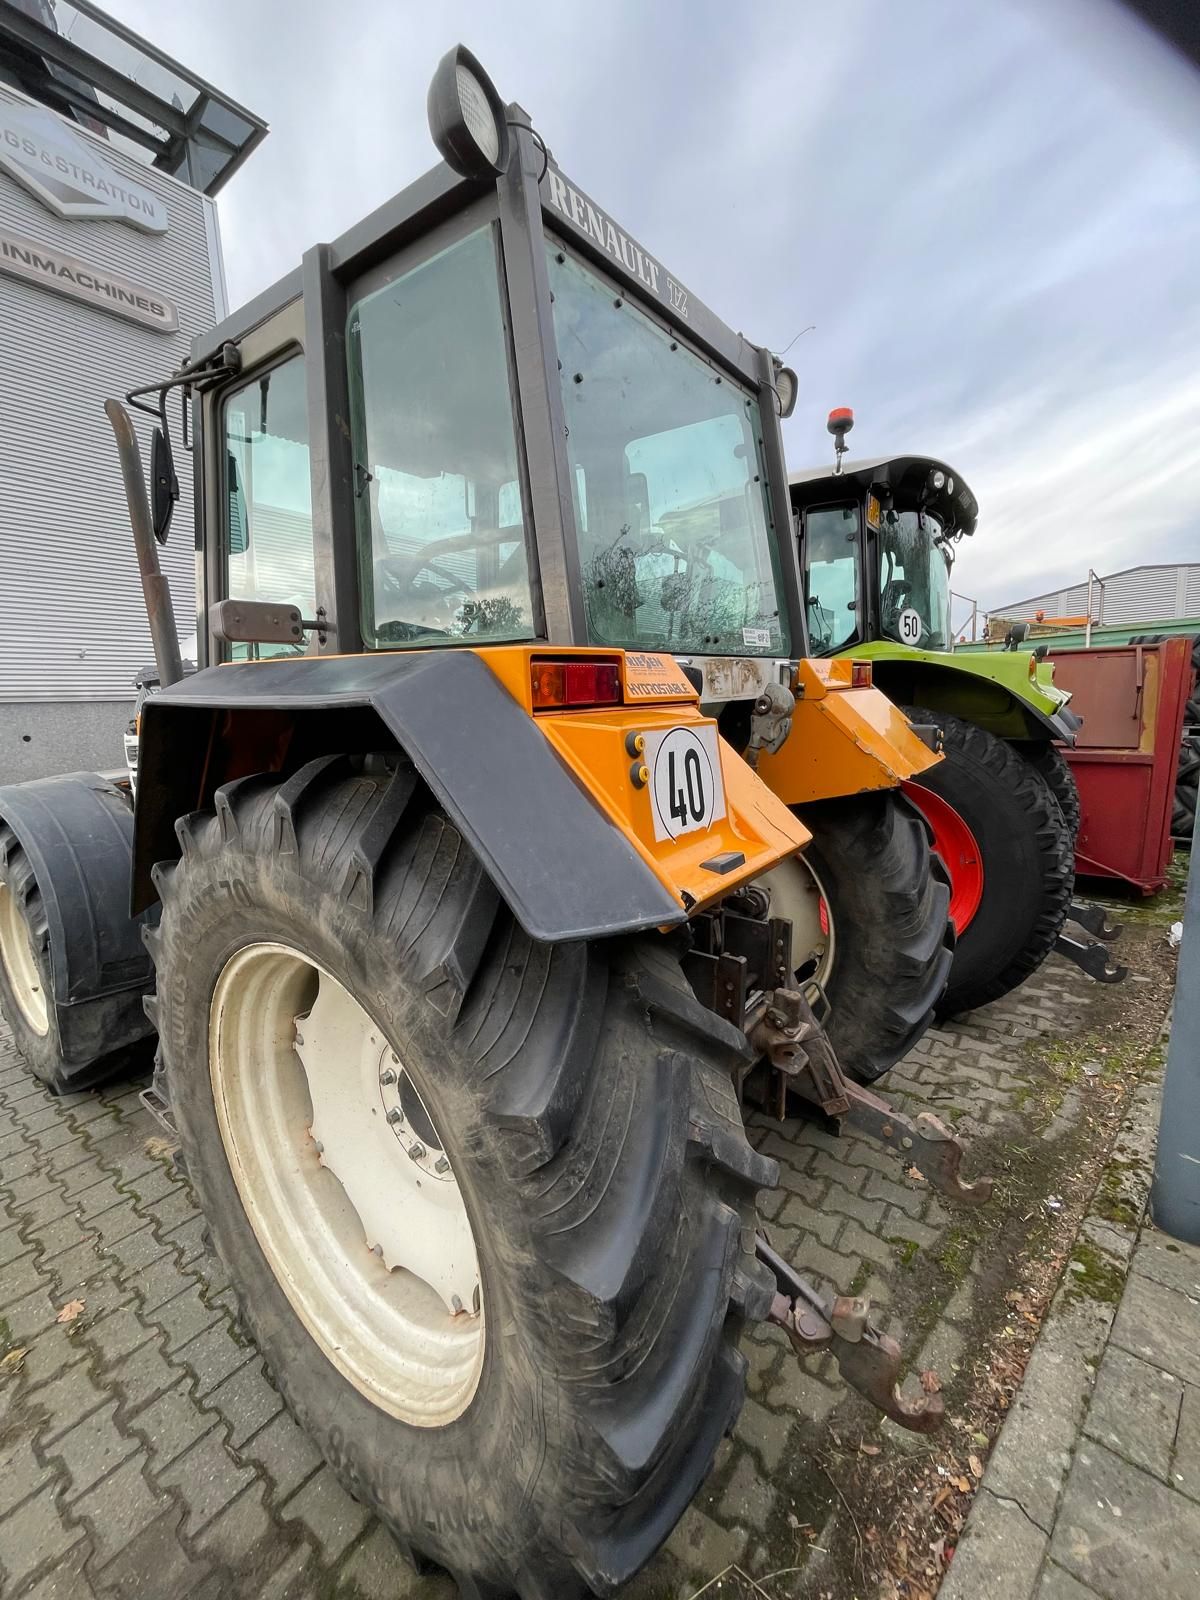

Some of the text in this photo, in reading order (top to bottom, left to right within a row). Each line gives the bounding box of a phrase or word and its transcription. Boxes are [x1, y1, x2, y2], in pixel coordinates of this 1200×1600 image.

[0, 128, 155, 218] GS&STRATTON
[547, 167, 660, 294] RENAULT
[2, 242, 166, 317] INMACHINES
[904, 615, 918, 638] 50
[627, 683, 691, 696] HYDROSTABLE
[668, 748, 706, 827] 40
